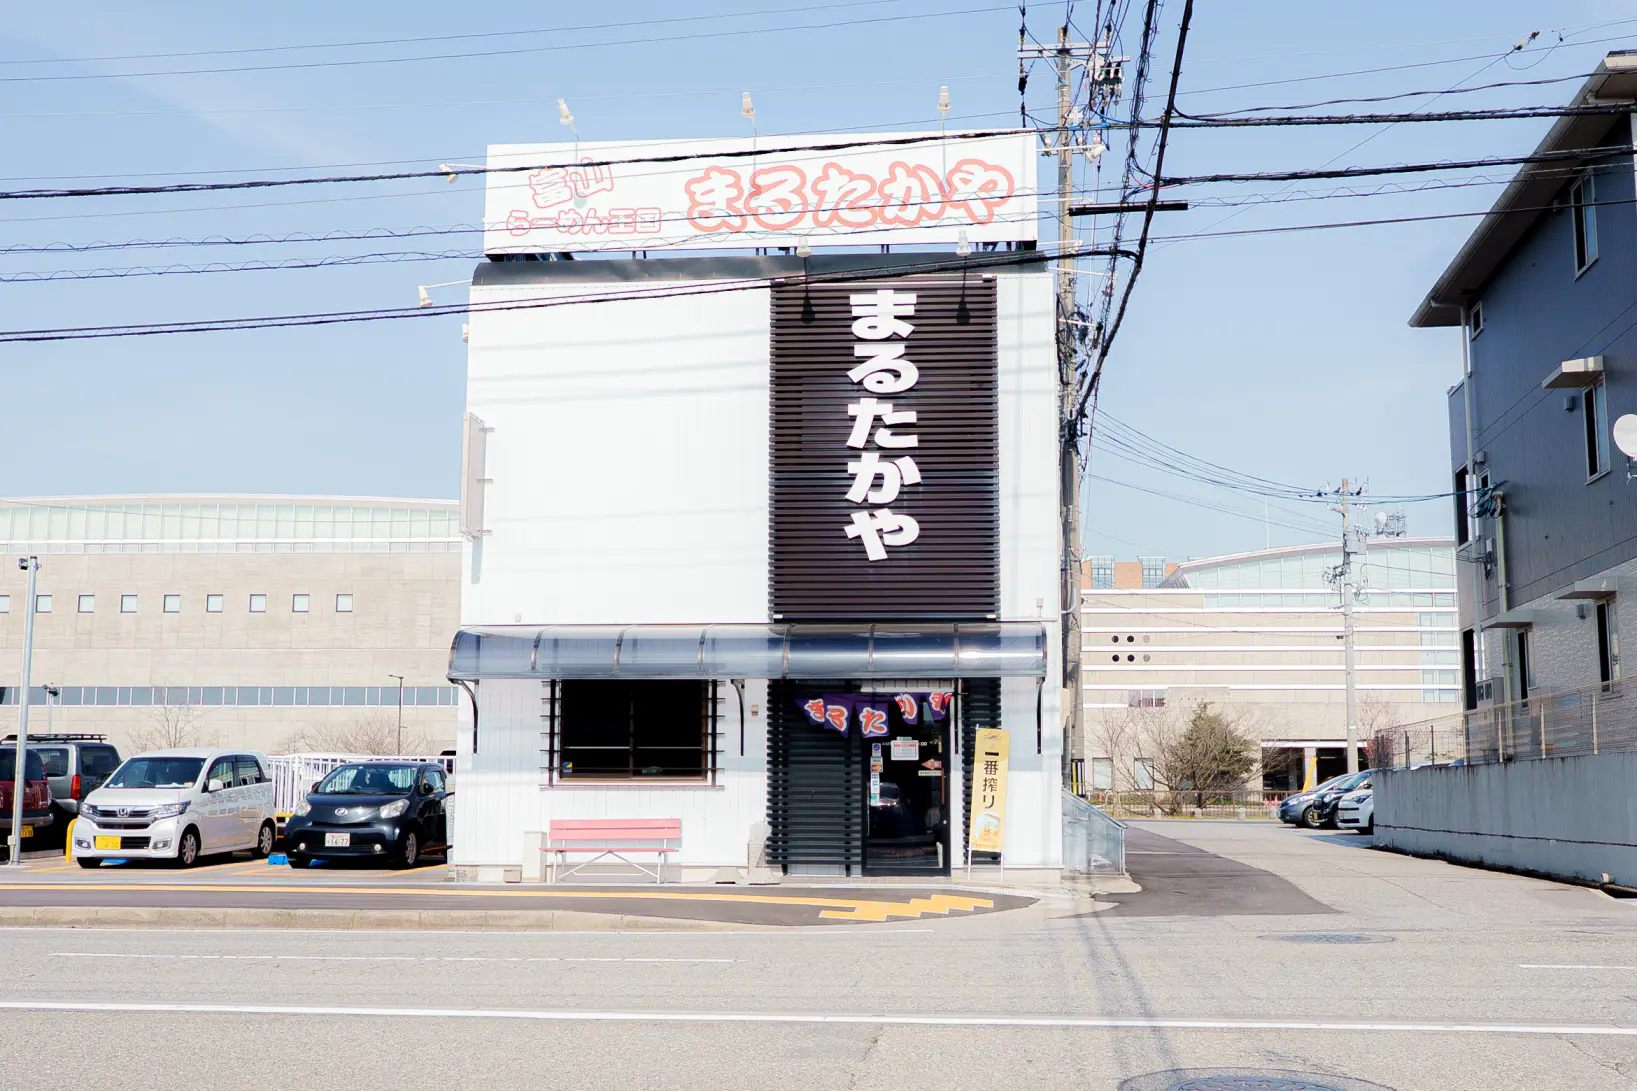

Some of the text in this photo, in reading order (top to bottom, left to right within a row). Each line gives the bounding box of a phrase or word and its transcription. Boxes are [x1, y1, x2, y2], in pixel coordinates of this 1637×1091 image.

[506, 207, 662, 237] らーめん王国
[684, 158, 1015, 232] まるたかや
[843, 289, 922, 562] まるたかや
[982, 751, 1000, 809] 一番搾り
